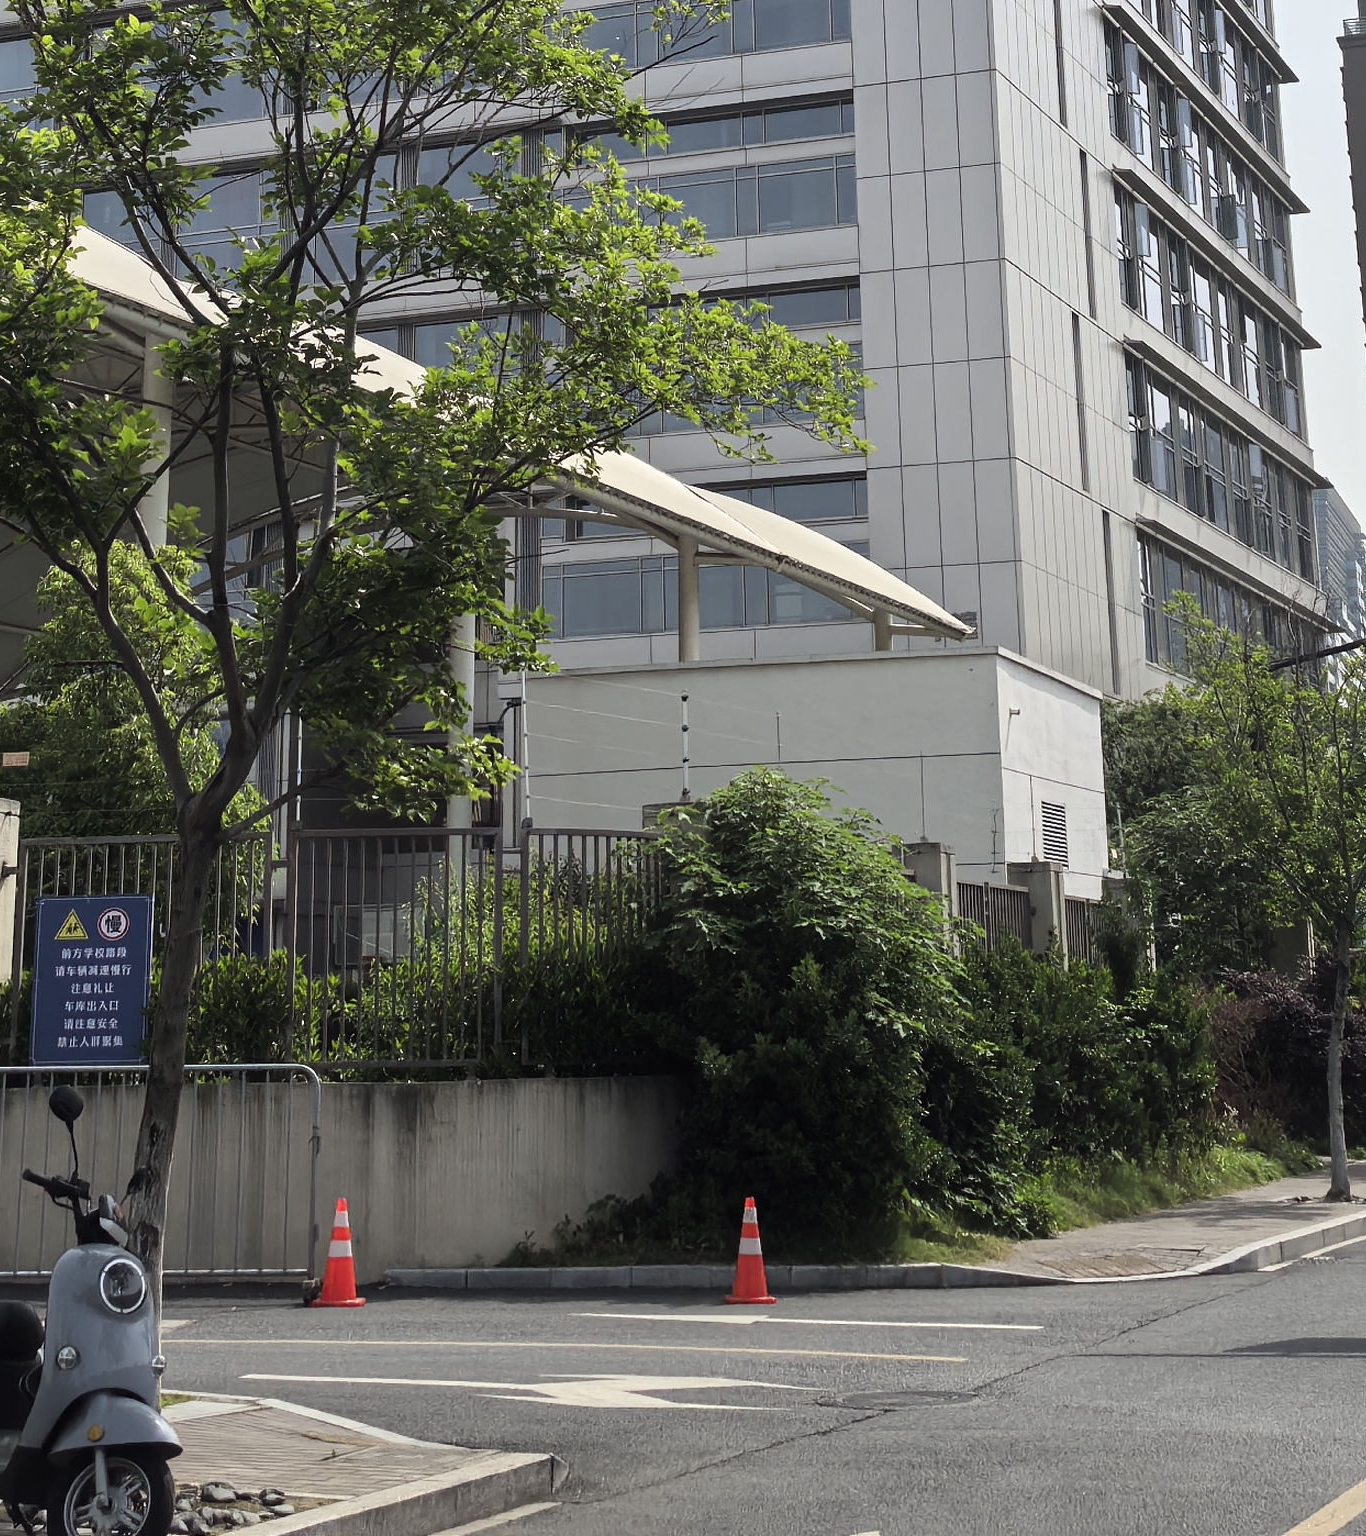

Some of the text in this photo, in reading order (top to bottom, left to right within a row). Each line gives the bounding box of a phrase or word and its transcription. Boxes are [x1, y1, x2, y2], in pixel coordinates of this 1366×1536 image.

[104, 914, 122, 934] 慢
[61, 947, 127, 960] 前方学校路段
[55, 964, 132, 977] 请车辆减速慢行
[71, 982, 114, 994] 注意礼让
[65, 1000, 119, 1012] 车库出入口
[63, 1018, 118, 1030] 请注意安全
